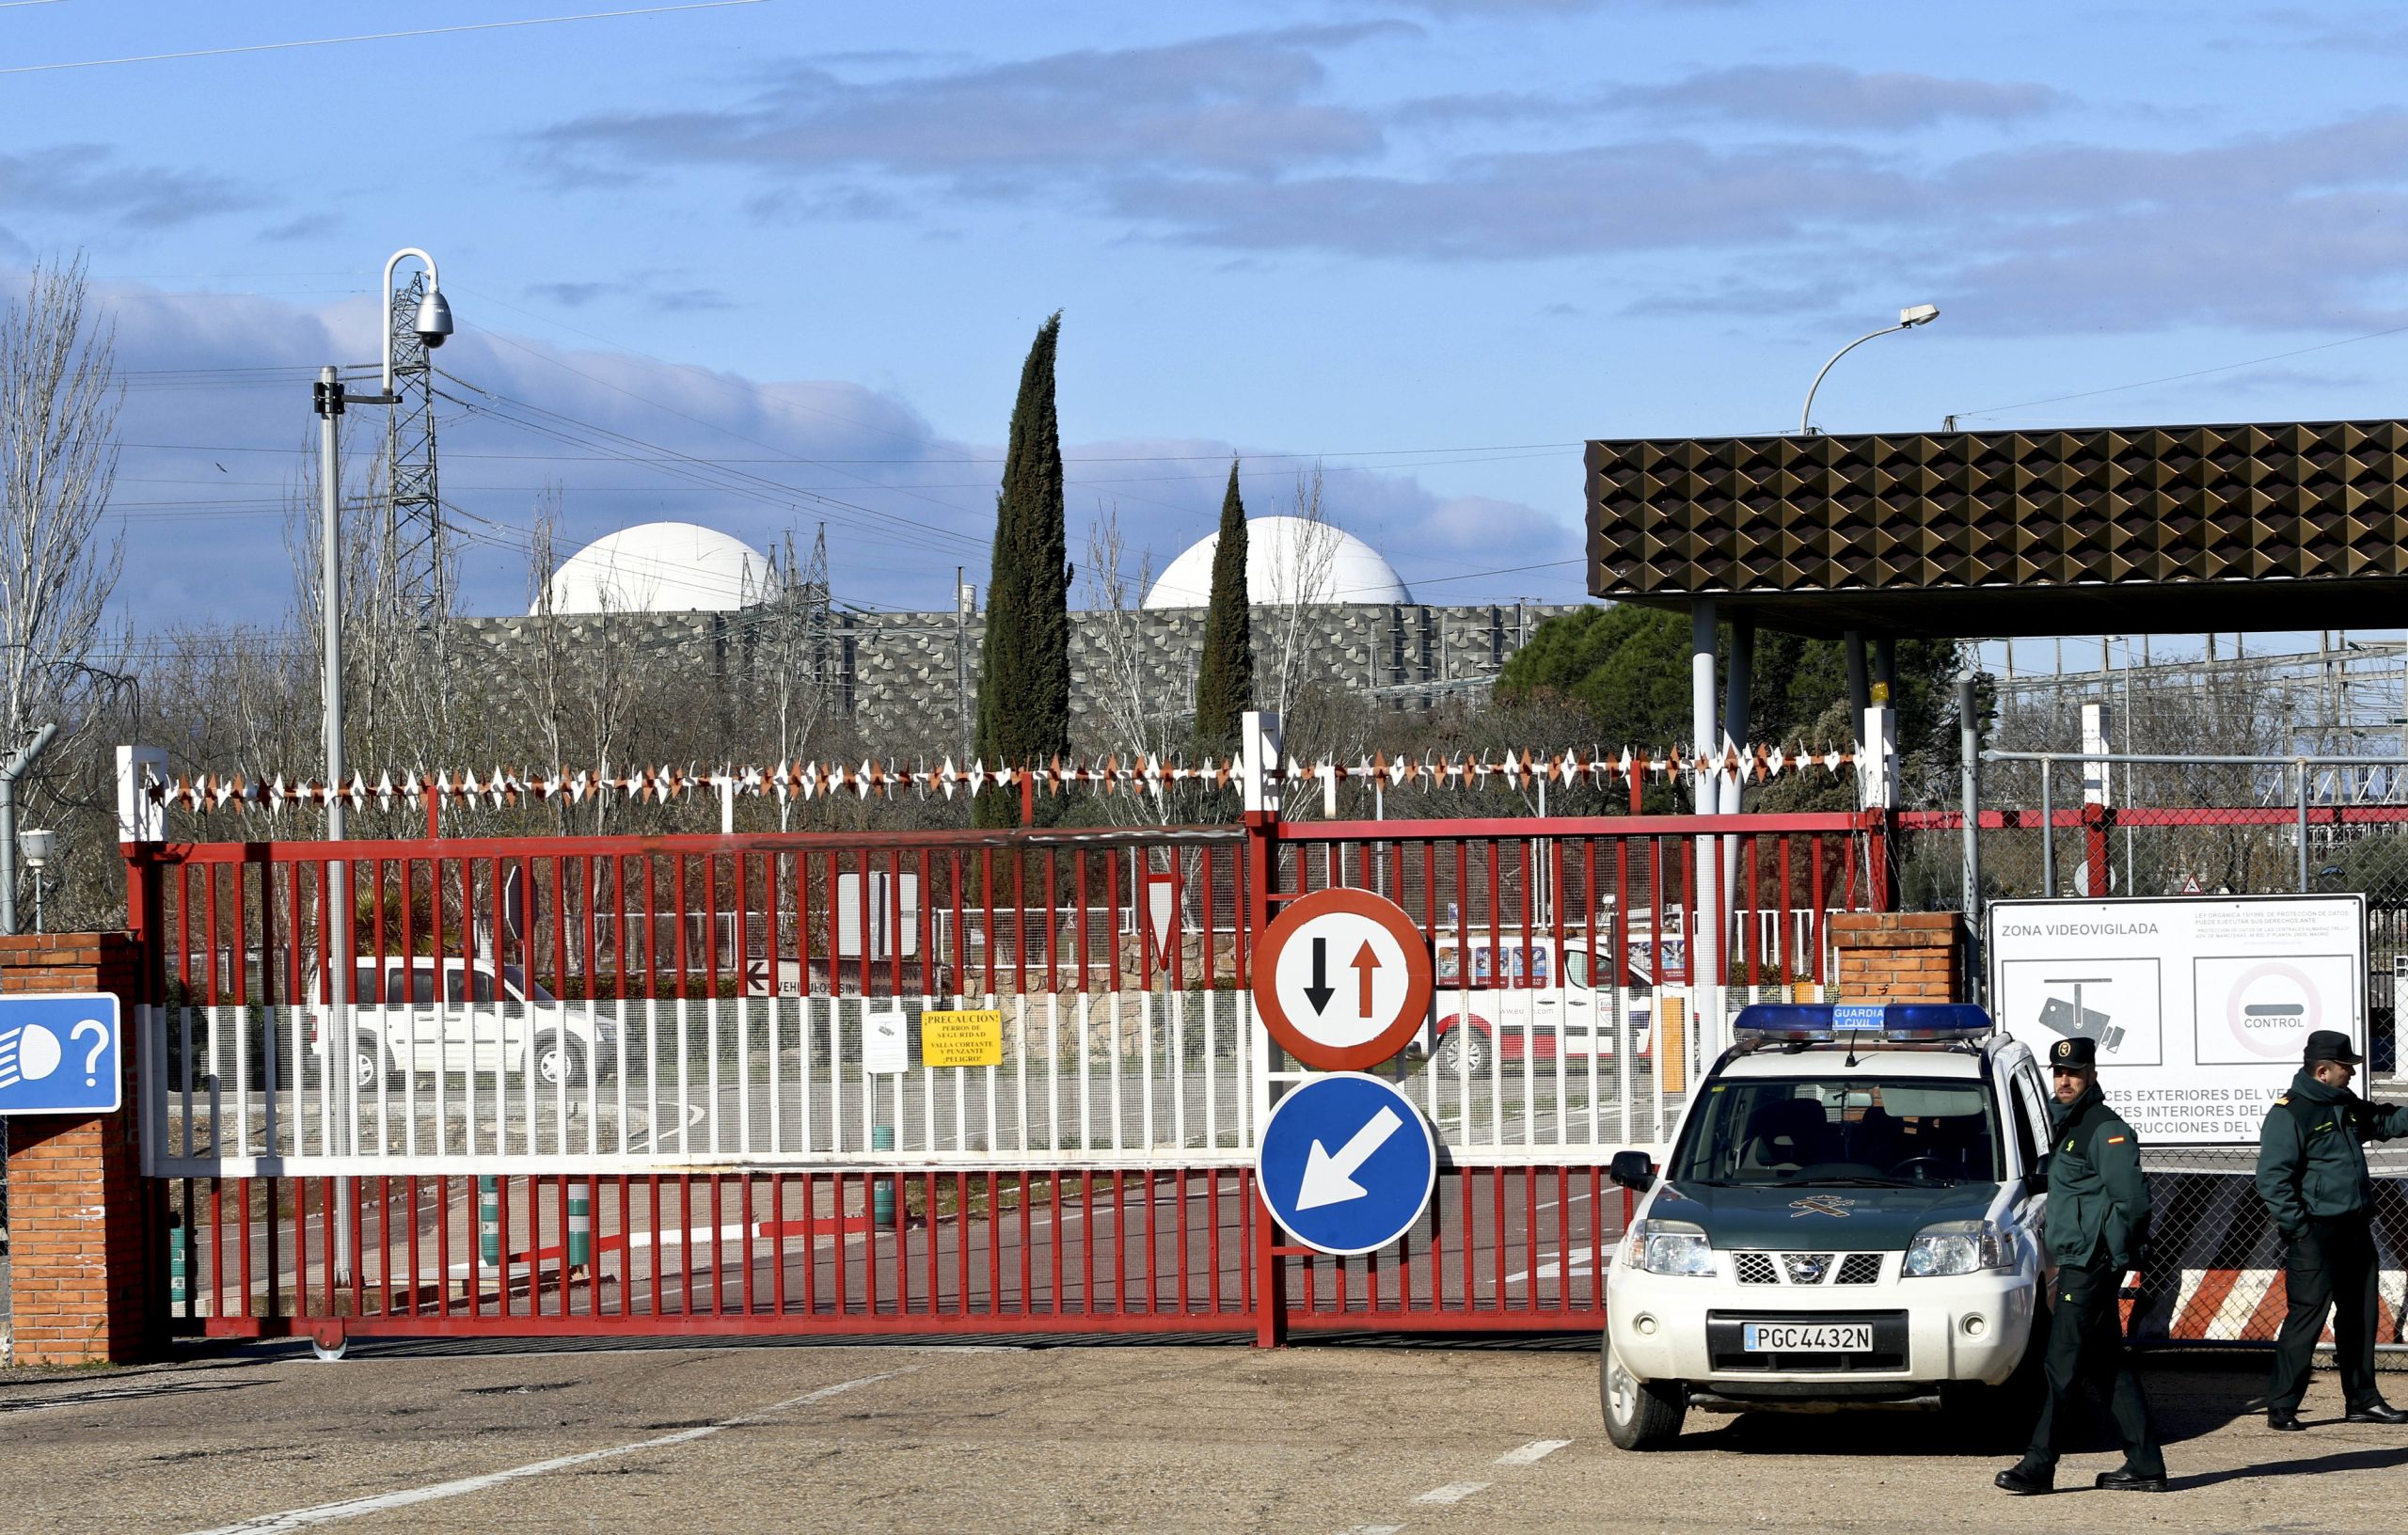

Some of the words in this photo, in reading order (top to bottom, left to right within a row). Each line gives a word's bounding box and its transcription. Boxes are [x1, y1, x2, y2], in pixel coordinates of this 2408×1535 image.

[2002, 925, 2042, 937] ZONA
[2045, 923, 2159, 936] VIDEOVIGILADA
[778, 981, 832, 993] VEHIULOS
[839, 984, 855, 994] SIN
[924, 1012, 999, 1026] ¡PRECAUCIÓN!
[1834, 1008, 1884, 1018] GUARDIA
[1845, 1018, 1871, 1026] CIVIL
[2244, 1017, 2305, 1028] CONTROL
[943, 1055, 982, 1064] ¡PELIGRO!
[2137, 1089, 2229, 1101] EXTERIORES
[2234, 1089, 2262, 1100] DEL
[2147, 1105, 2234, 1116] INTERIORES
[2240, 1104, 2267, 1116] DEL
[2224, 1121, 2252, 1132] DEL
[1758, 1327, 1869, 1348] PGC4432N
